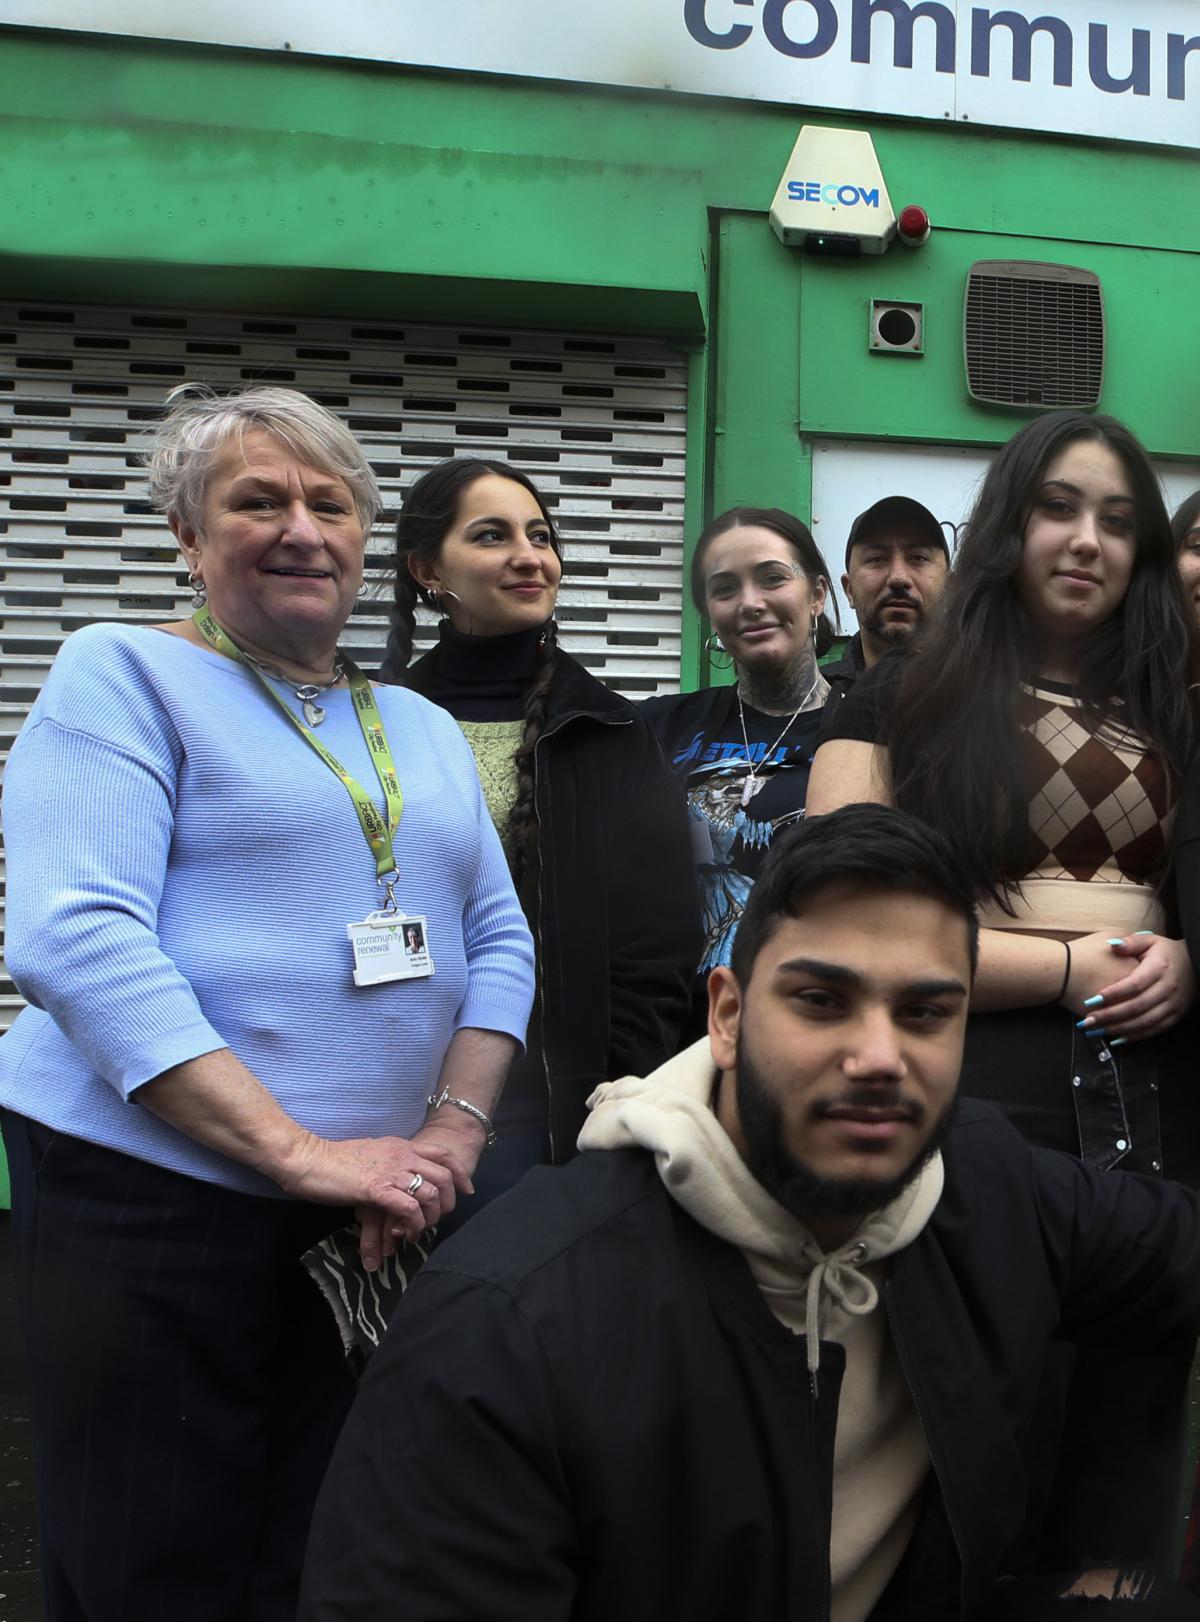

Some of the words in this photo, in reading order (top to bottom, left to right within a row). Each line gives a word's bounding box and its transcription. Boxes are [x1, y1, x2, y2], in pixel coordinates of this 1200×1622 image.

[787, 181, 879, 208] SECOM
[358, 801, 377, 833] URBACT
[356, 932, 403, 946] community
[357, 942, 390, 955] renewal
